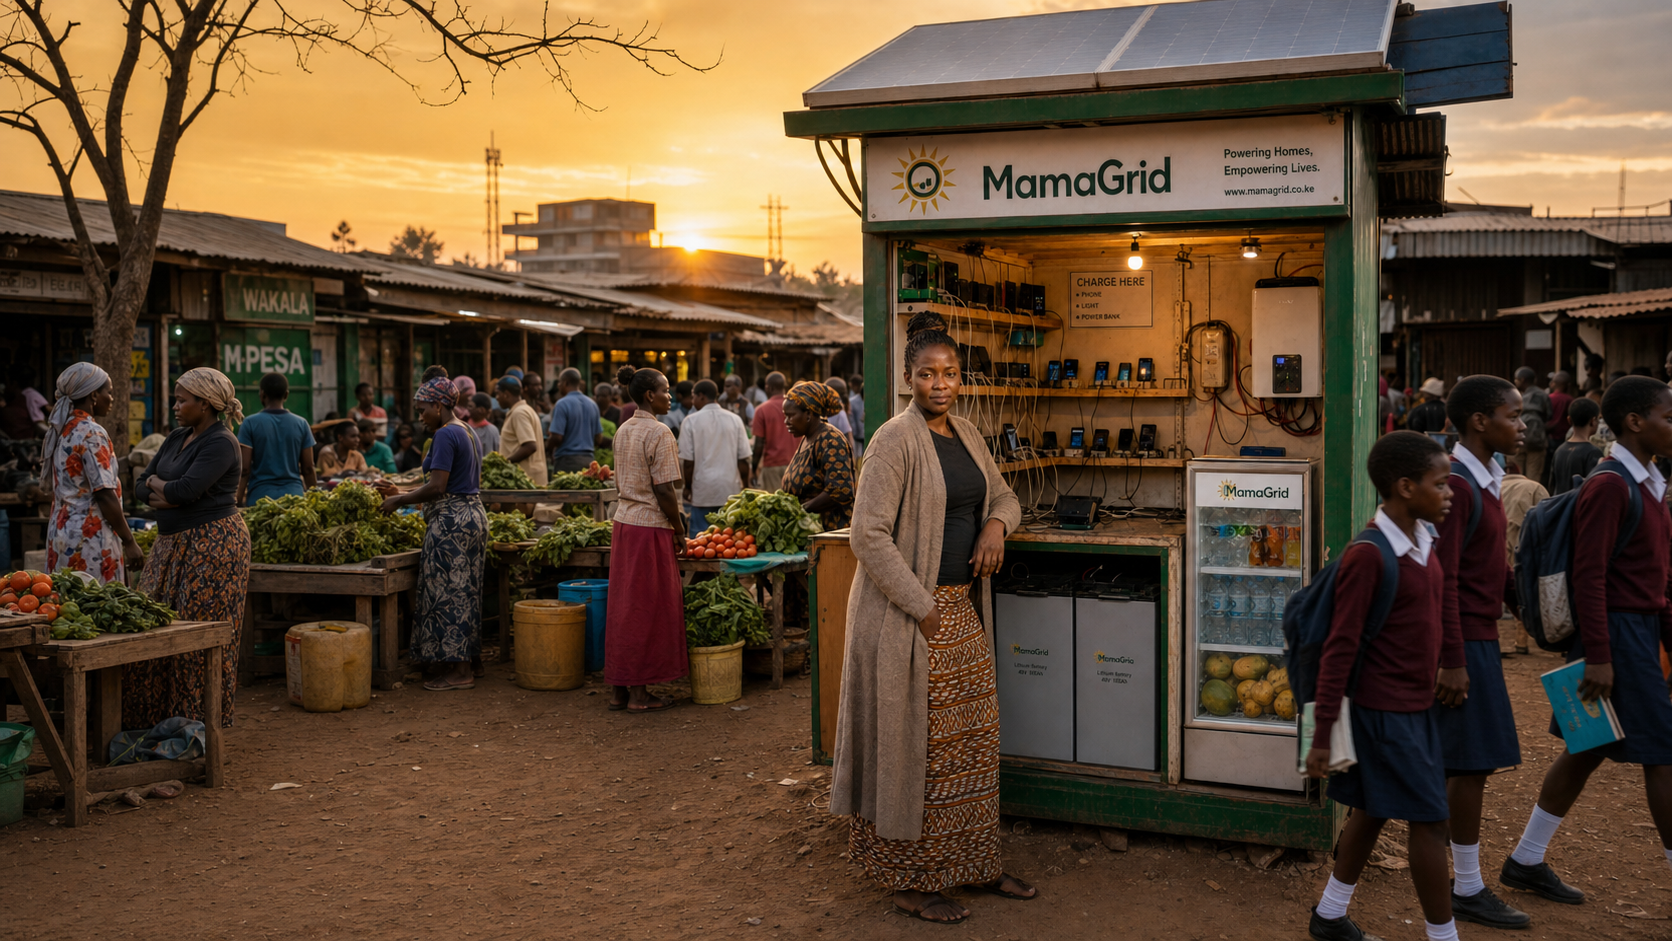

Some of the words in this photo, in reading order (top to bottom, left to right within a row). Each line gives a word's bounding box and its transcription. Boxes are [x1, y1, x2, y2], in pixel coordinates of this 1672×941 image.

[1224, 147, 1271, 159] Powering
[1274, 146, 1313, 157] Homes,
[1224, 164, 1288, 177] Empowering
[1291, 163, 1320, 173] Lives.
[983, 156, 1171, 200] MamaGrid
[1224, 185, 1315, 196] www.mamagrid.co.ke
[1076, 277, 1117, 287] CHARGE
[1119, 276, 1145, 286] HERE
[243, 288, 310, 315] WAKALA
[1226, 485, 1289, 498] MamaGrid
